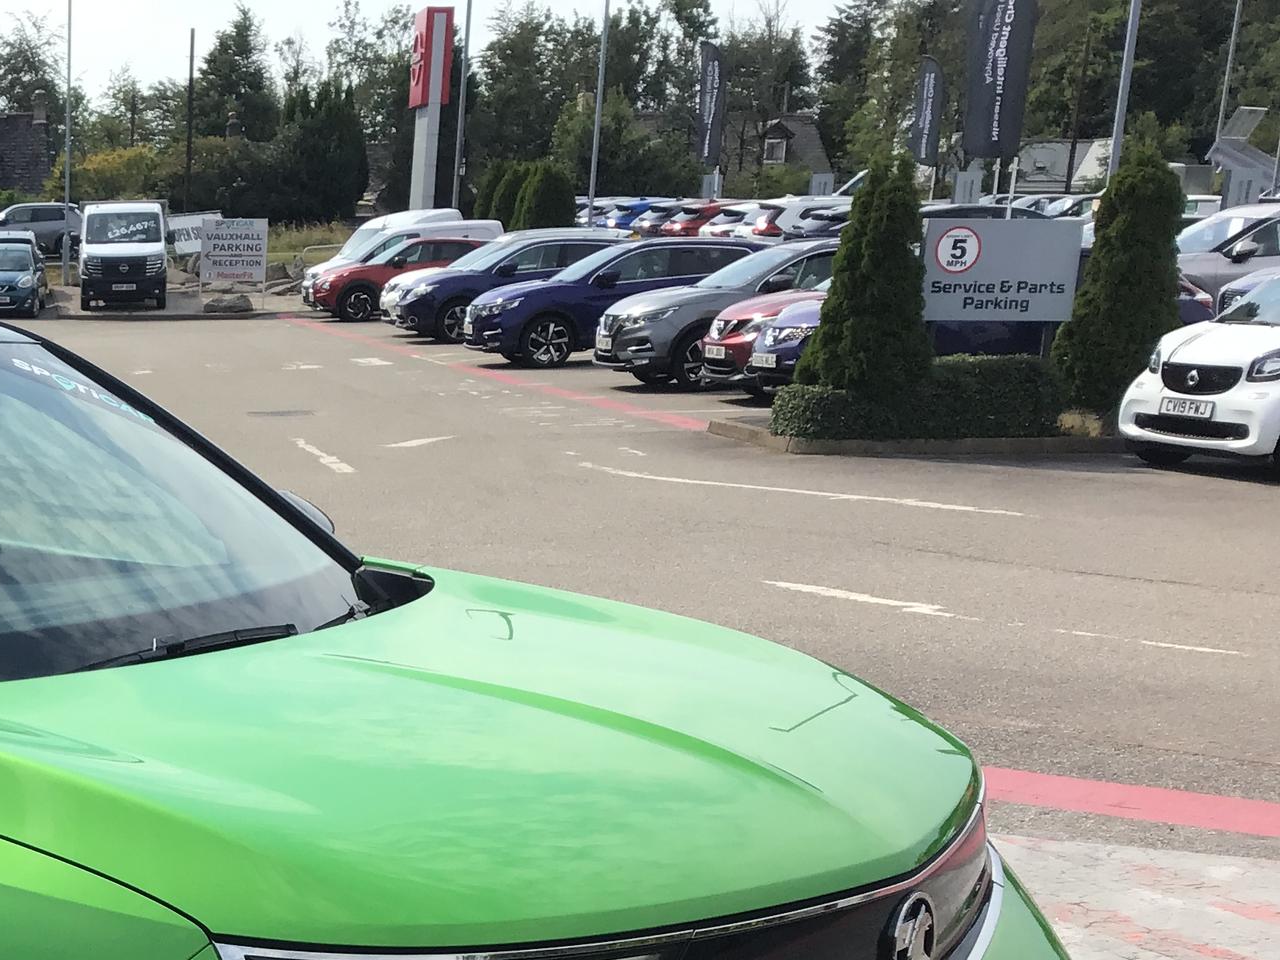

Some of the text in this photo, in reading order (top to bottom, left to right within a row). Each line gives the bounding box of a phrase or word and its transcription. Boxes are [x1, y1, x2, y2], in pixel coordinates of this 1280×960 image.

[206, 232, 263, 241] VAUXHALL
[212, 243, 262, 252] PARKING
[950, 238, 968, 260] 5
[212, 259, 262, 267] RECEPTION
[945, 259, 968, 268] MPH
[930, 280, 1066, 294] Service & Parts
[962, 296, 1031, 312] Parking
